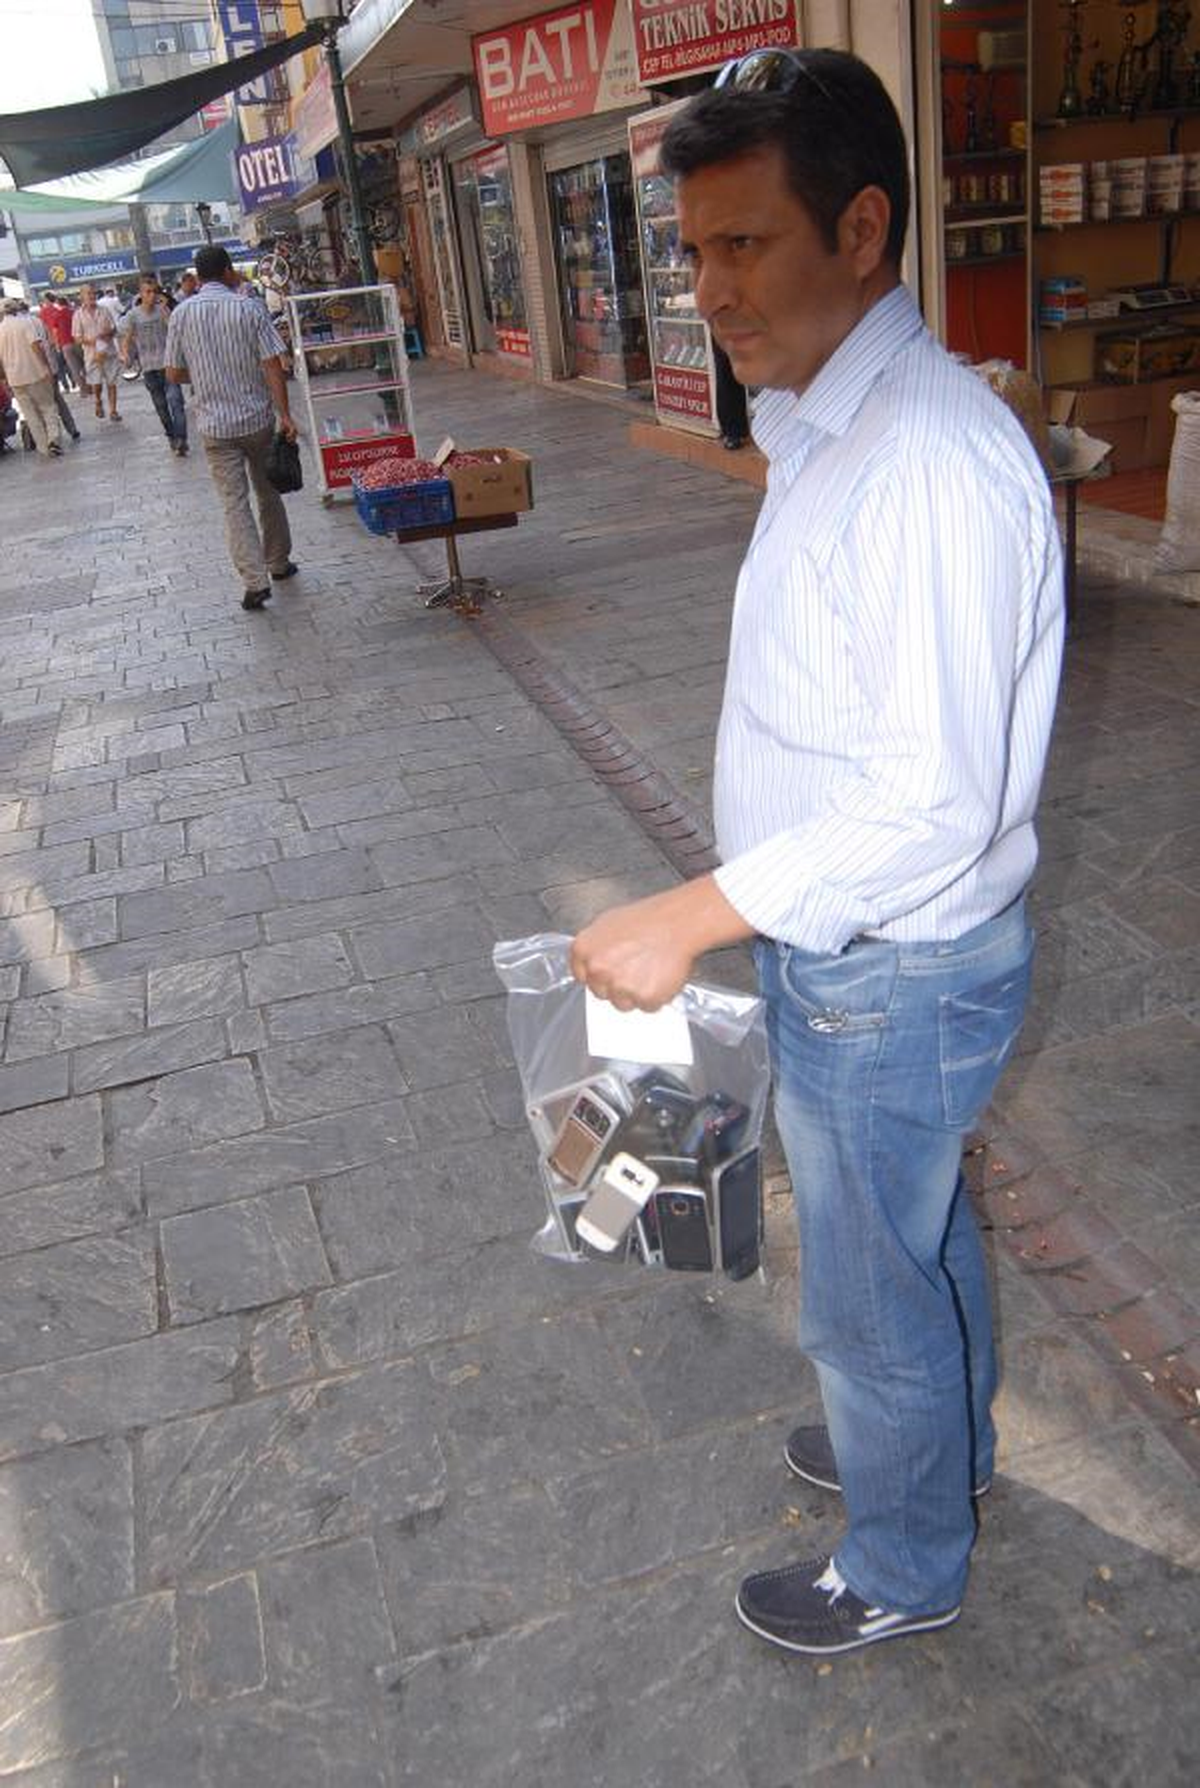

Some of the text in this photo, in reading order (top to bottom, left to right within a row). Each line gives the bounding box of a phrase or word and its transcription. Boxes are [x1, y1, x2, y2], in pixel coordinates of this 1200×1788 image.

[480, 9, 599, 98] BATI
[239, 145, 289, 192] OTEL
[72, 261, 125, 277] TURKCELL
